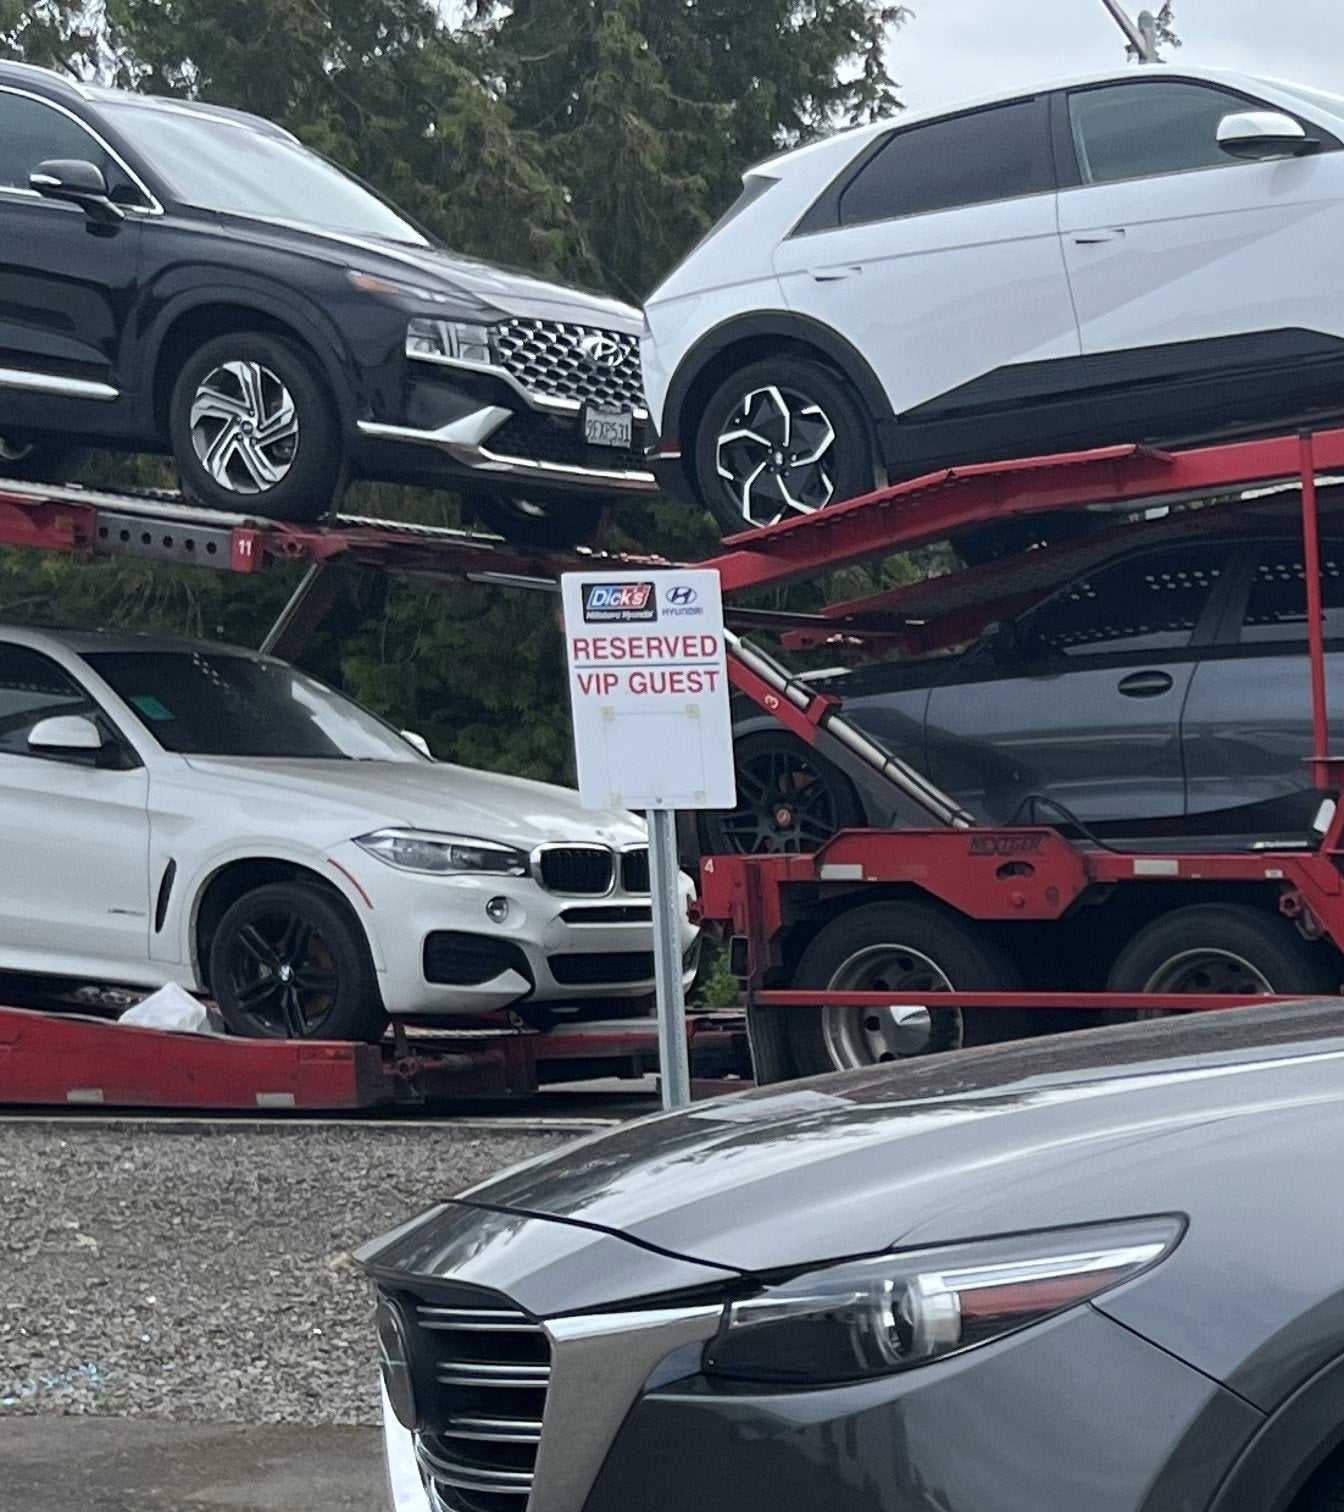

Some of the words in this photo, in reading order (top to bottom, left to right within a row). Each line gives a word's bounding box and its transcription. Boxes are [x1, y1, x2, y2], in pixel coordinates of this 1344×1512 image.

[573, 636, 718, 659] RESERVED
[576, 672, 619, 695] VIP
[628, 670, 720, 694] GUEST
